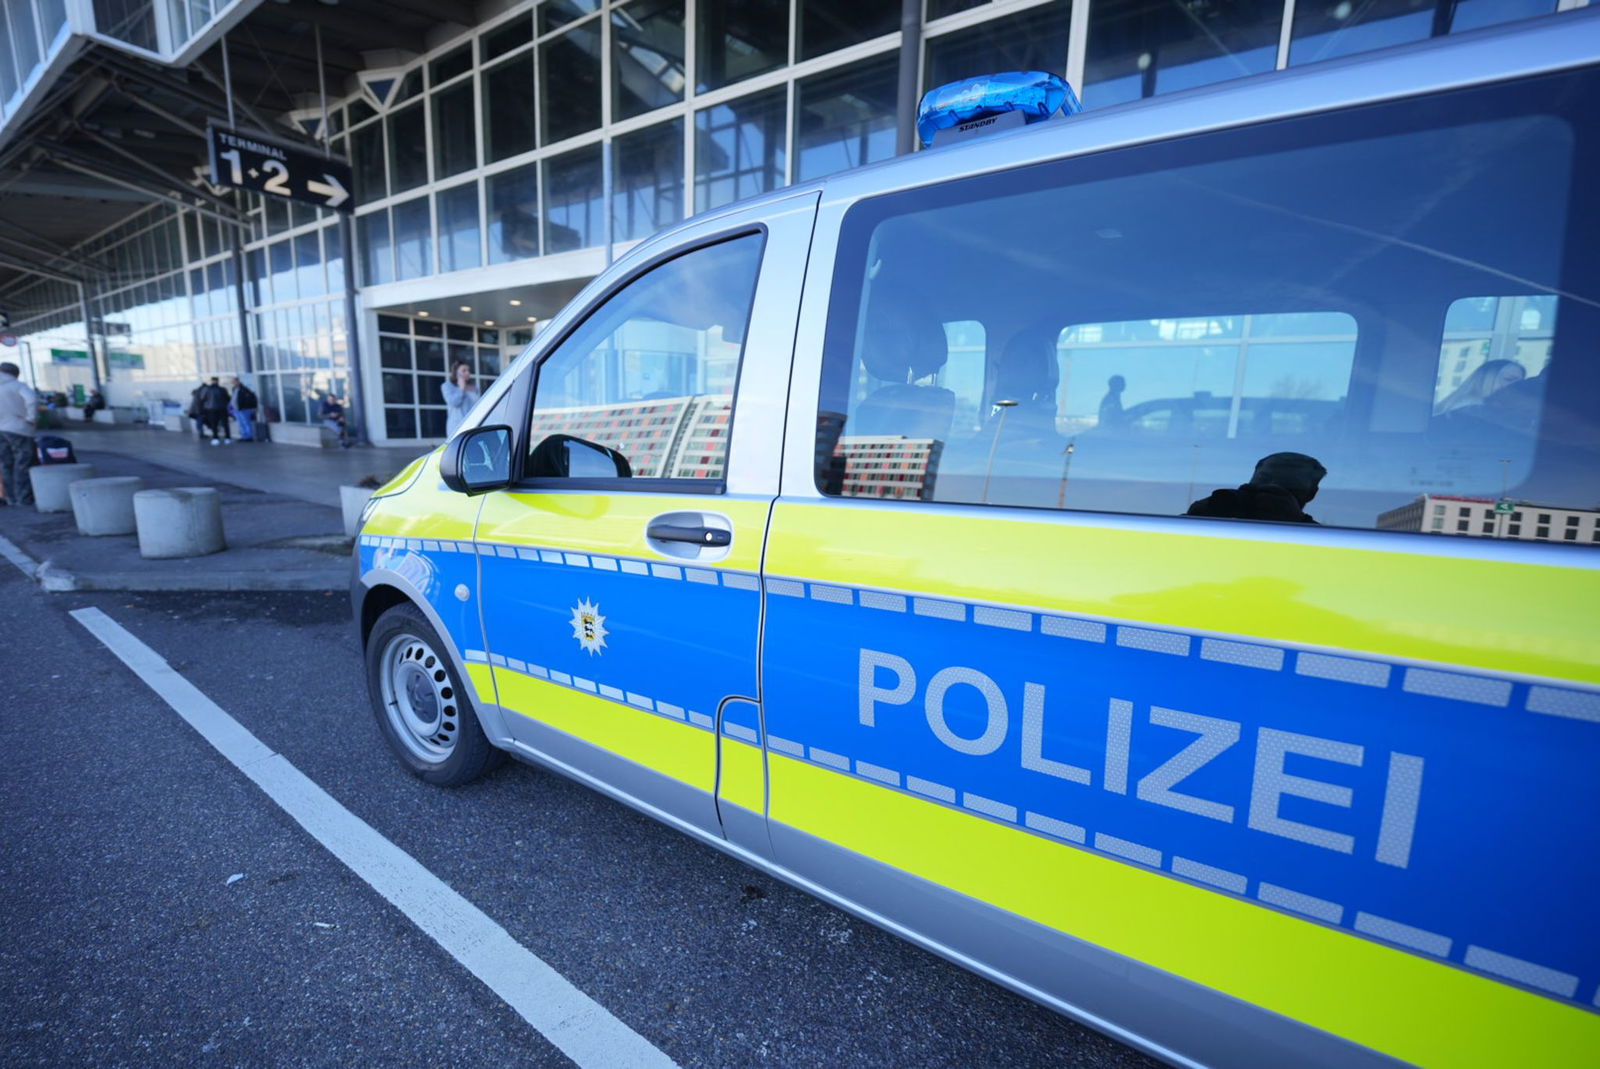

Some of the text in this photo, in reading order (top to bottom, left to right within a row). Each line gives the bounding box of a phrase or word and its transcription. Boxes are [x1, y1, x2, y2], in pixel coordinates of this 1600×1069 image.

[959, 117, 998, 132] STANDBY
[219, 133, 287, 160] TERMINAL
[859, 648, 1425, 869] POLIZEI
